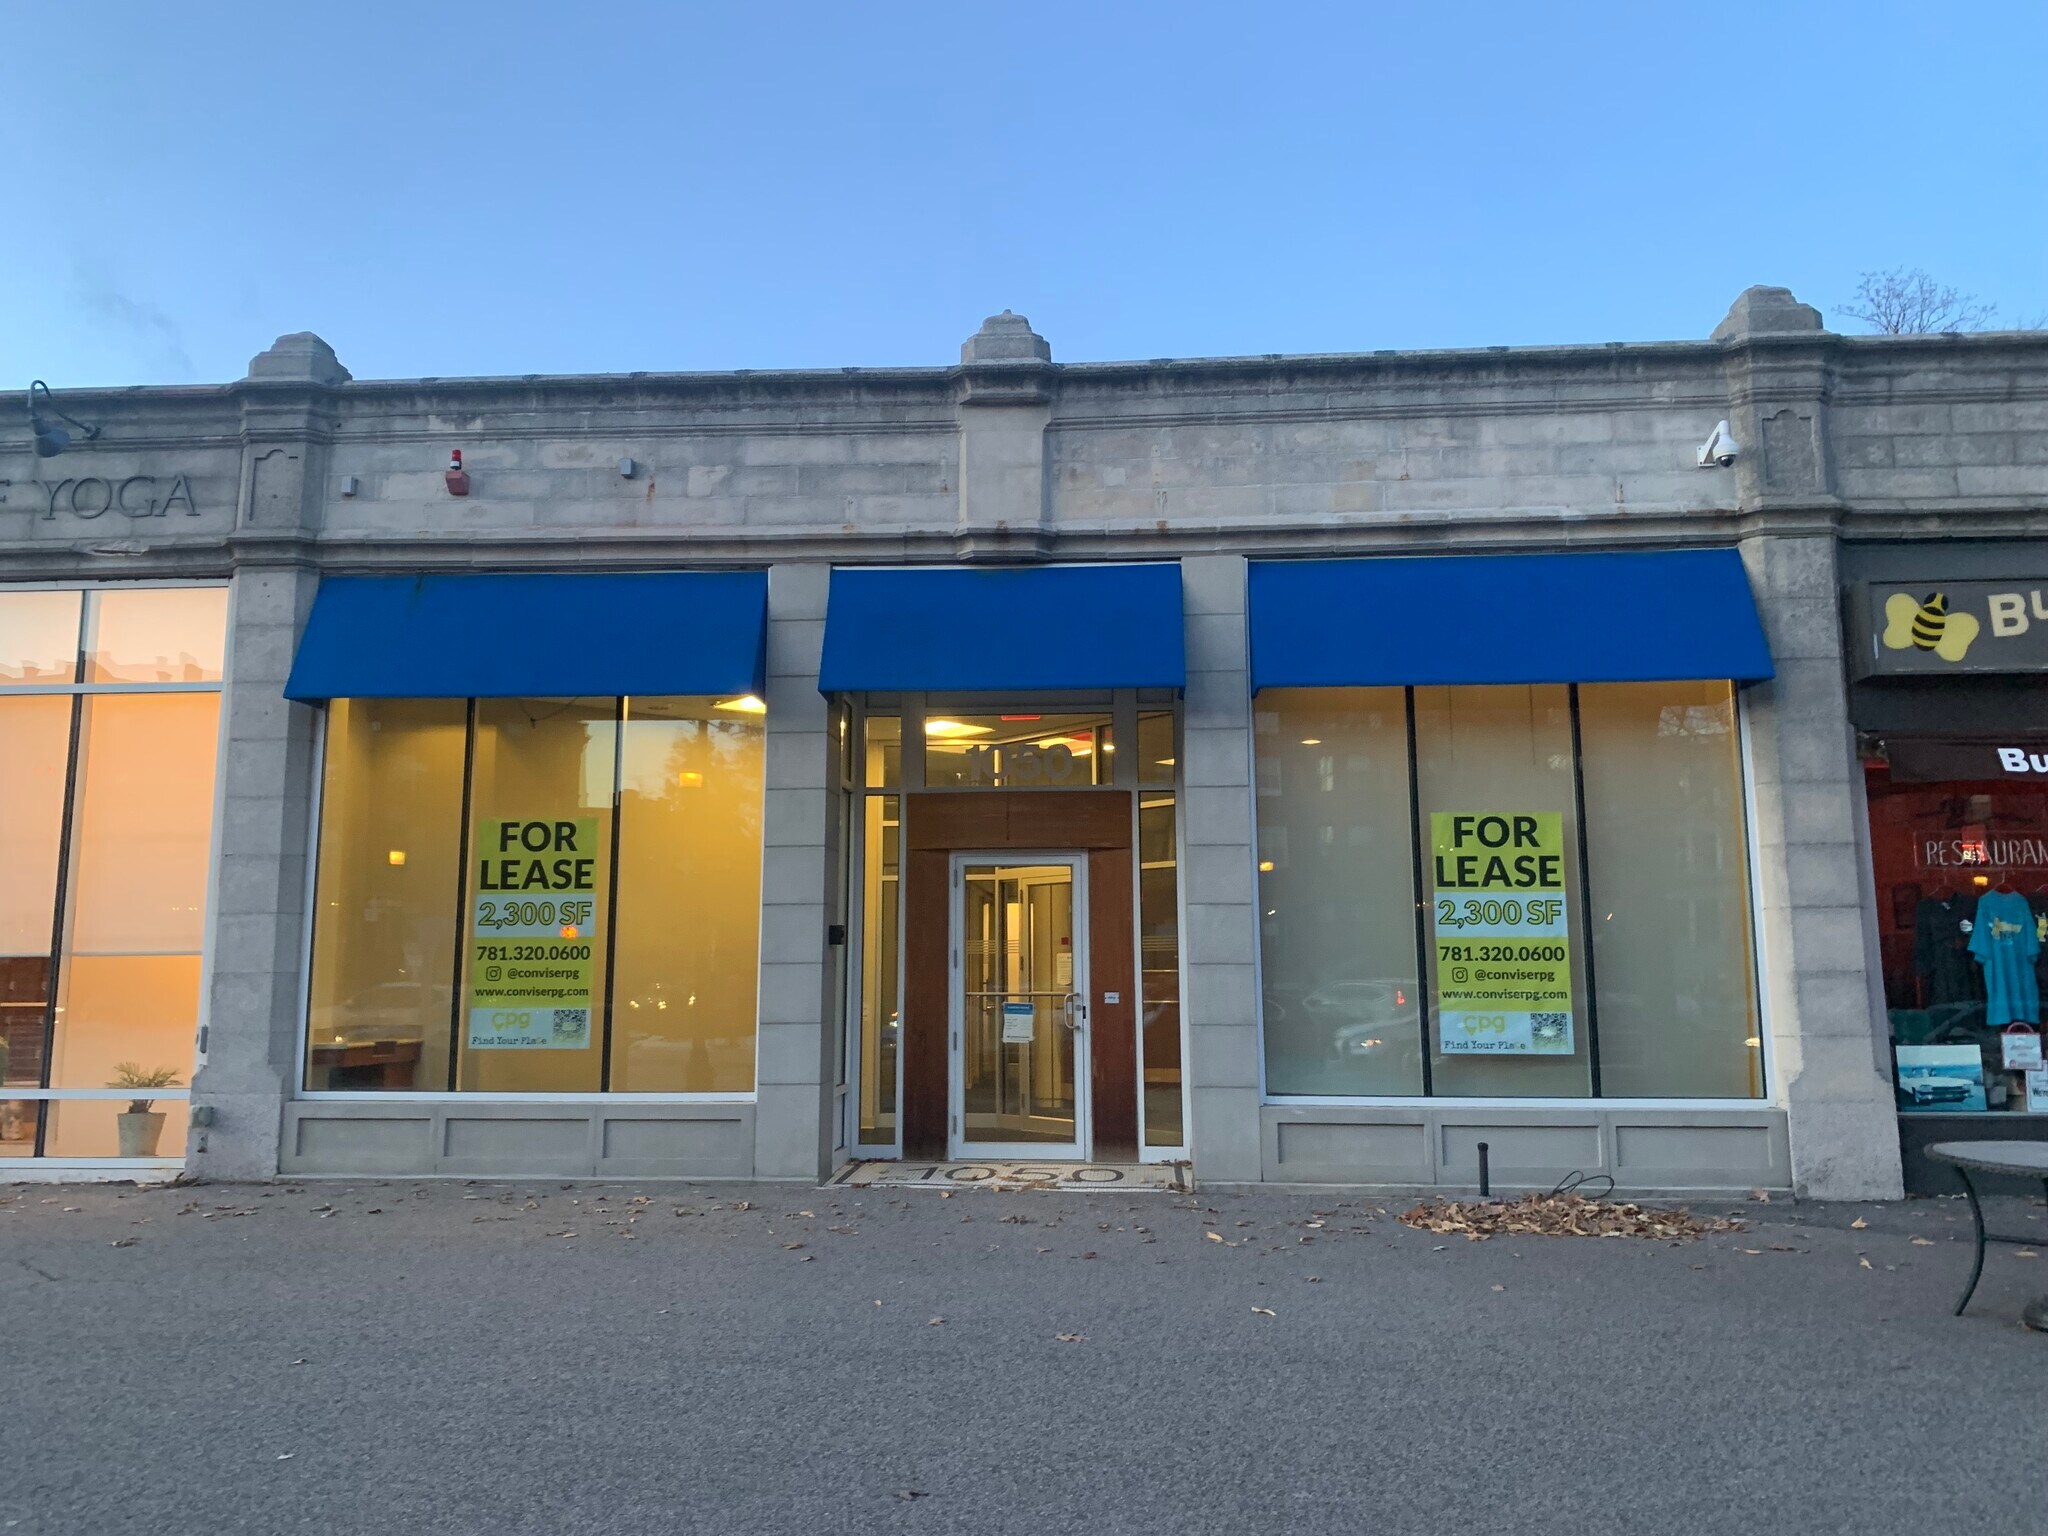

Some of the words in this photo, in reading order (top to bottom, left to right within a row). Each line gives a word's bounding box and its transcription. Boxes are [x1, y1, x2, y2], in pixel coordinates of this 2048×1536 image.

[32, 473, 201, 520] YOGA
[500, 821, 578, 852] FOR
[1453, 816, 1540, 848] FOR
[1926, 838, 2048, 865] RESAURAN
[480, 859, 594, 890] LEASE
[1435, 855, 1562, 888] LEASE
[478, 902, 556, 930] 2,300
[559, 901, 592, 926] SF
[1438, 900, 1522, 929] 2,300
[1527, 900, 1563, 925] SF
[477, 946, 591, 961] 781.320.0600
[1440, 946, 1565, 962] 781.320.0600
[507, 968, 580, 980] @conviserpg
[1474, 969, 1555, 982] @conviserpg
[475, 987, 589, 998] www.conviserpg.com
[1442, 989, 1568, 1001] www.conviserpg.com
[492, 1012, 530, 1031] cpg
[1464, 1015, 1505, 1036] cpg
[472, 1036, 494, 1045] Find
[496, 1036, 519, 1045] Your
[520, 1036, 547, 1045] Plae
[1444, 1040, 1469, 1050] Find
[1470, 1040, 1496, 1050] Your
[1498, 1040, 1527, 1050] Plae
[908, 1166, 1124, 1183] 1050
